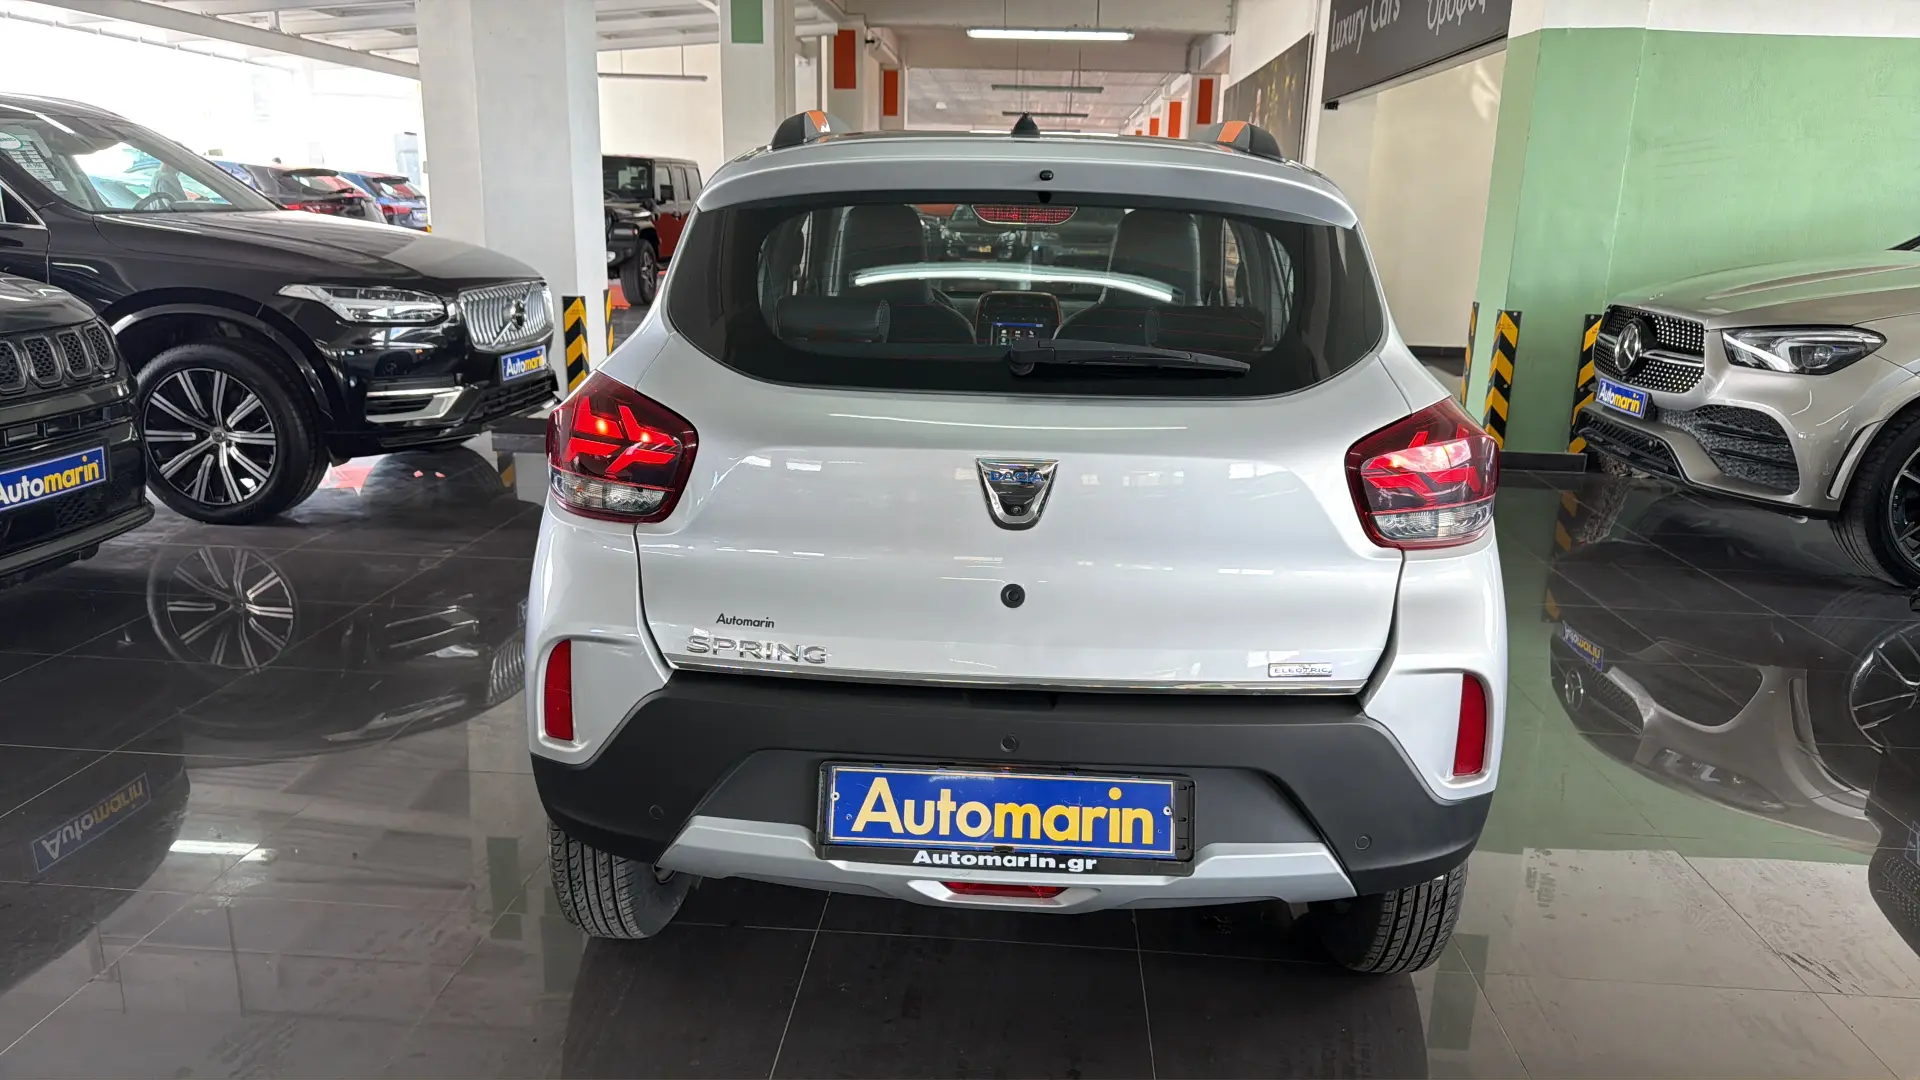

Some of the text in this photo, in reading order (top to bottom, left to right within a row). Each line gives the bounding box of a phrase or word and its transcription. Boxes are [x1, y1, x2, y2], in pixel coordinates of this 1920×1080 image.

[1330, 5, 1369, 54] Luxury
[1599, 382, 1641, 414] Automarin
[715, 612, 775, 629] Automarin
[686, 634, 828, 665] SPRING
[851, 776, 1155, 845] Automarin
[912, 849, 1098, 873] Automarin.gr
